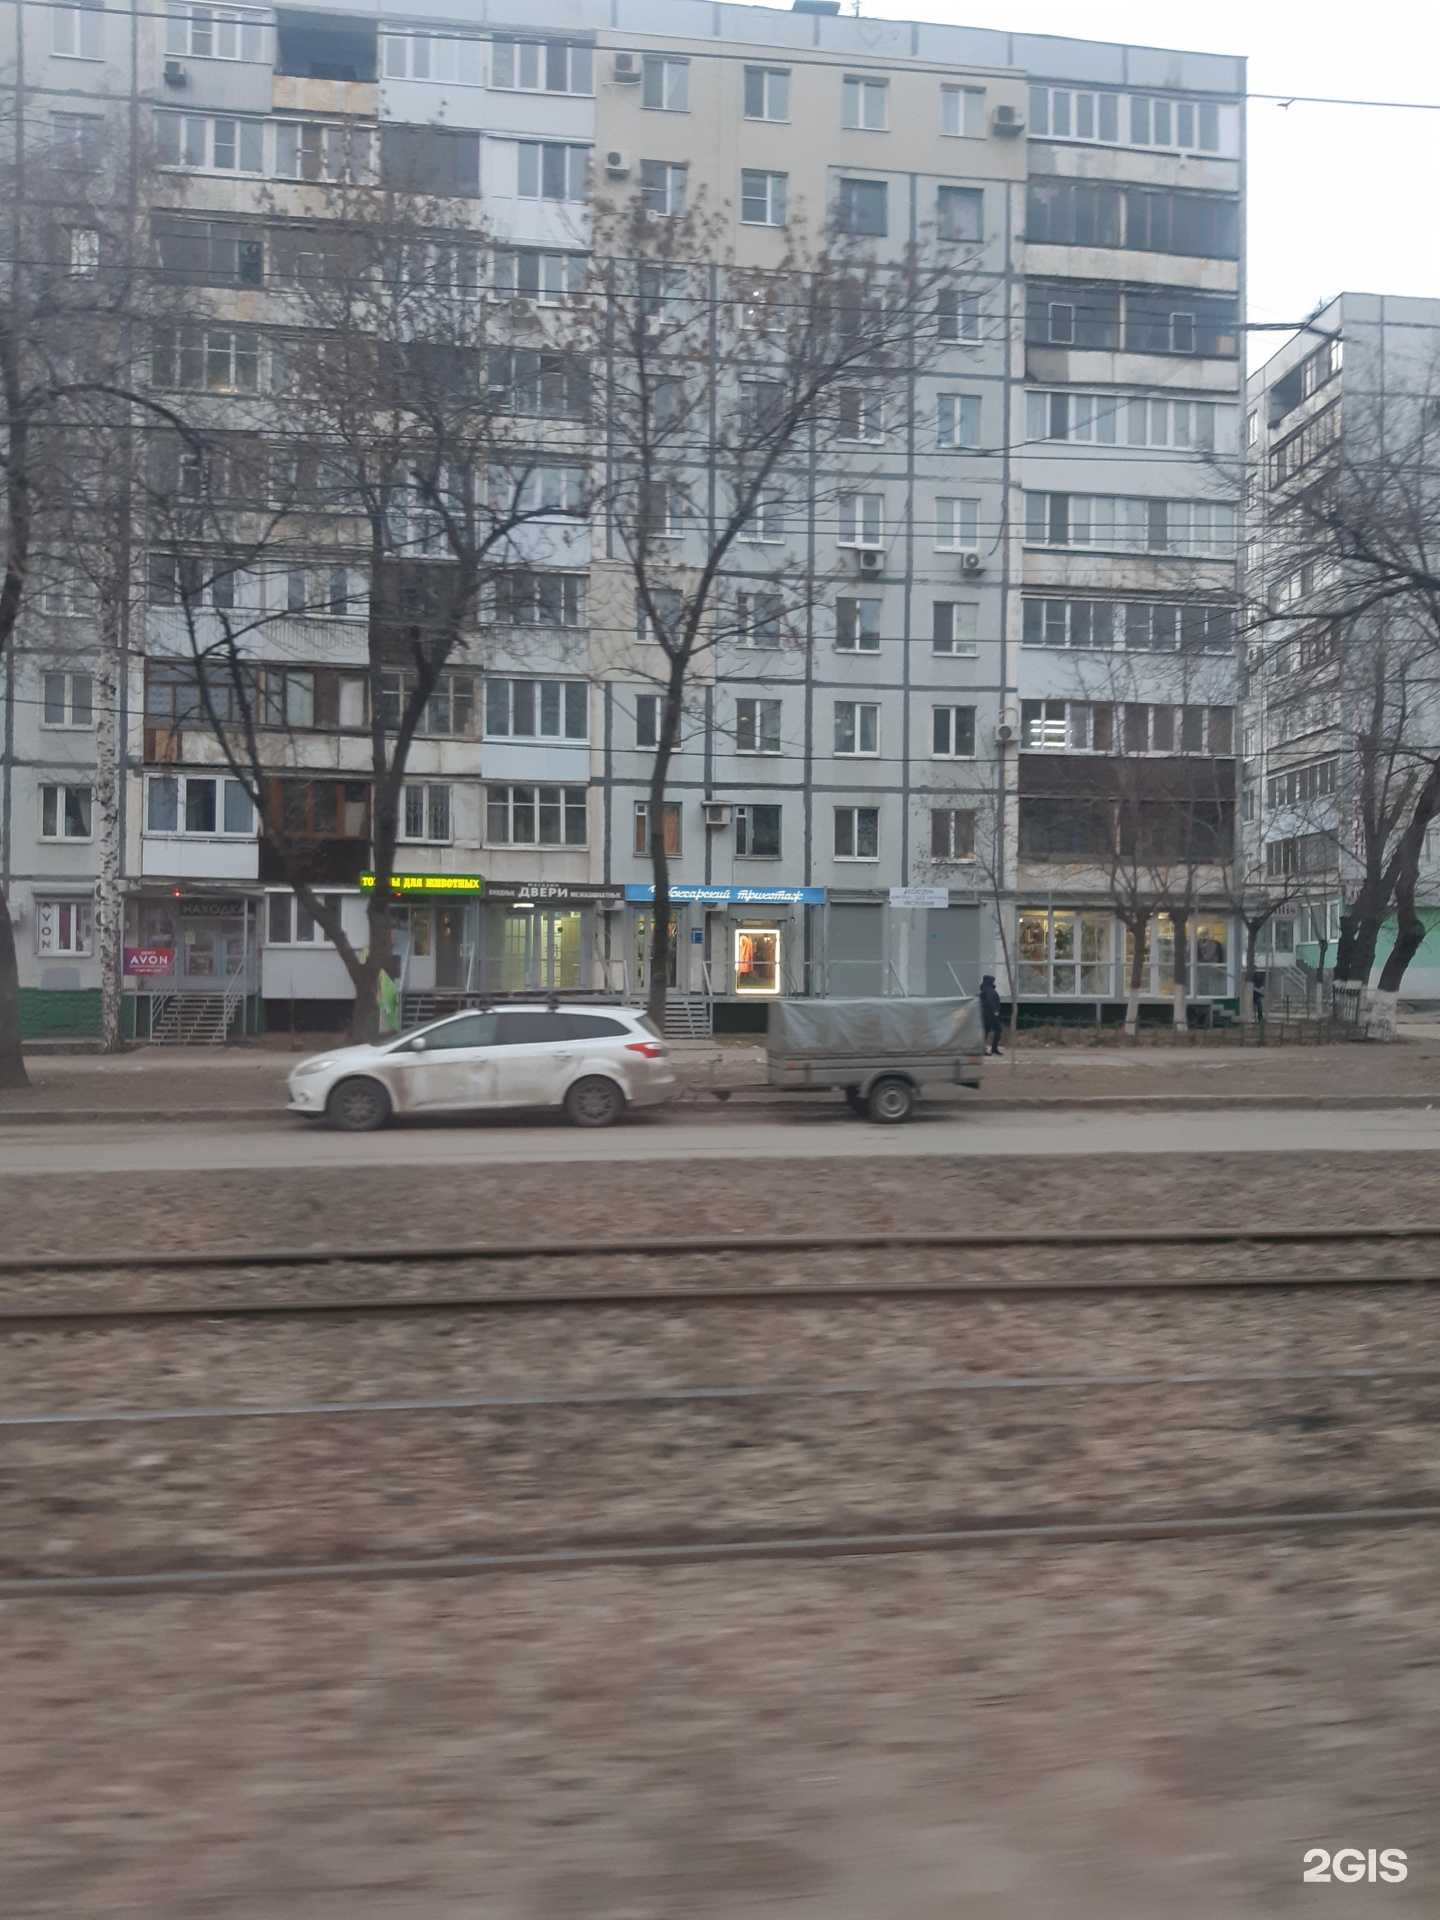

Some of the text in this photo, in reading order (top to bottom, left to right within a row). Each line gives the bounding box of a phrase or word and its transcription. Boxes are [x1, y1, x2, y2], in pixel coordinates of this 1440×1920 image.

[361, 877, 480, 888] ТОЫ ДЛЯ ЖИВОТНЫХ
[518, 887, 568, 898] ДВЕРИ
[130, 955, 168, 965] AVON
